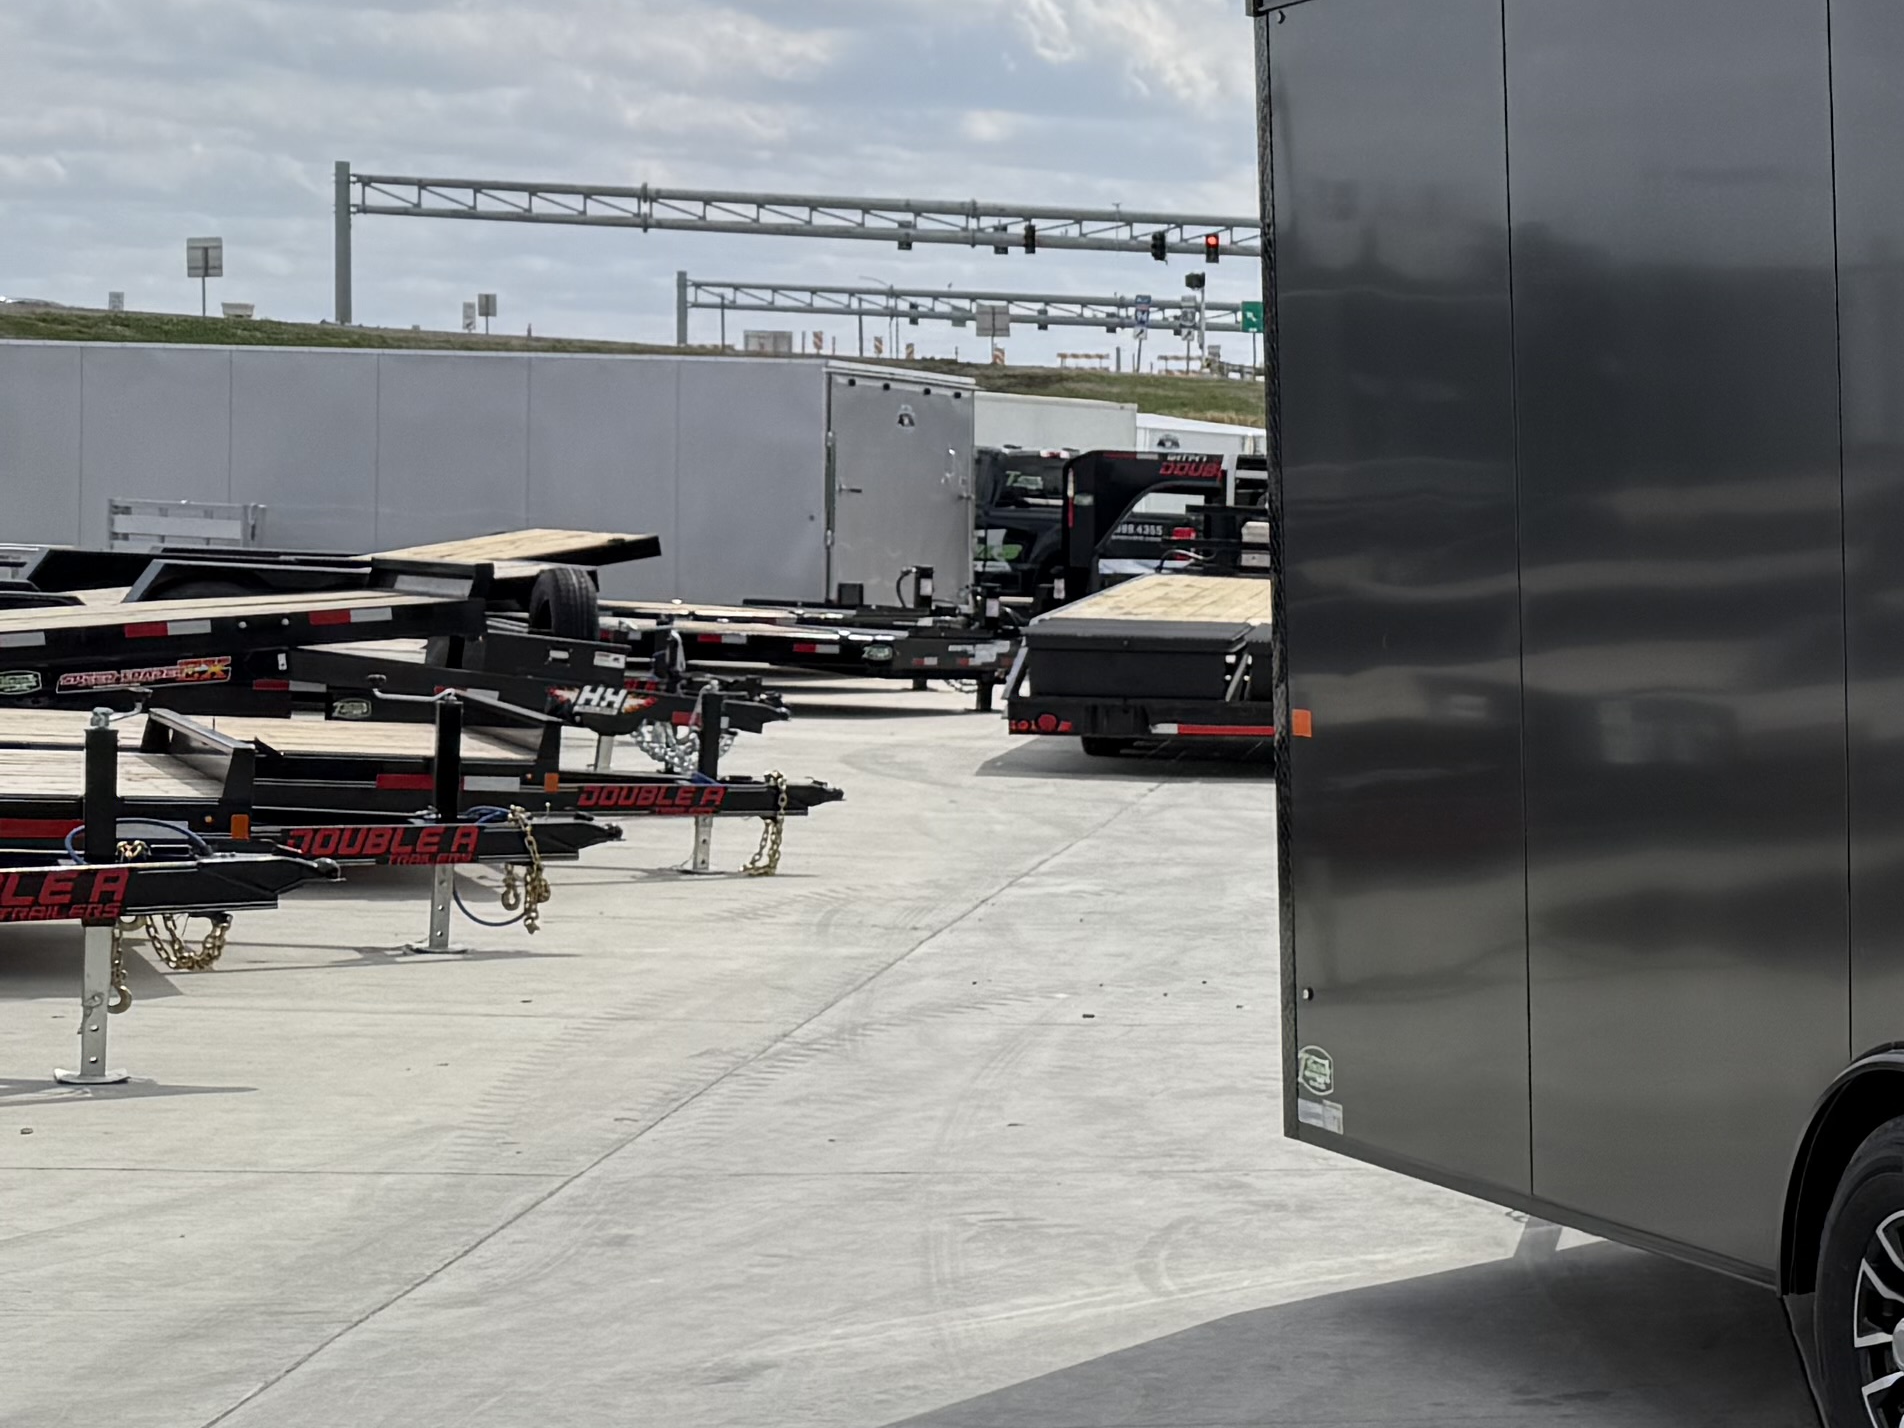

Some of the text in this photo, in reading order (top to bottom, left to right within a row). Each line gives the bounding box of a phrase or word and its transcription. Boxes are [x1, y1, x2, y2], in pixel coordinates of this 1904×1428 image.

[1159, 461, 1220, 478] DOUB
[578, 785, 727, 807] DOUBLE A
[287, 825, 480, 857] DOUBLE A
[0, 868, 130, 906] LE A
